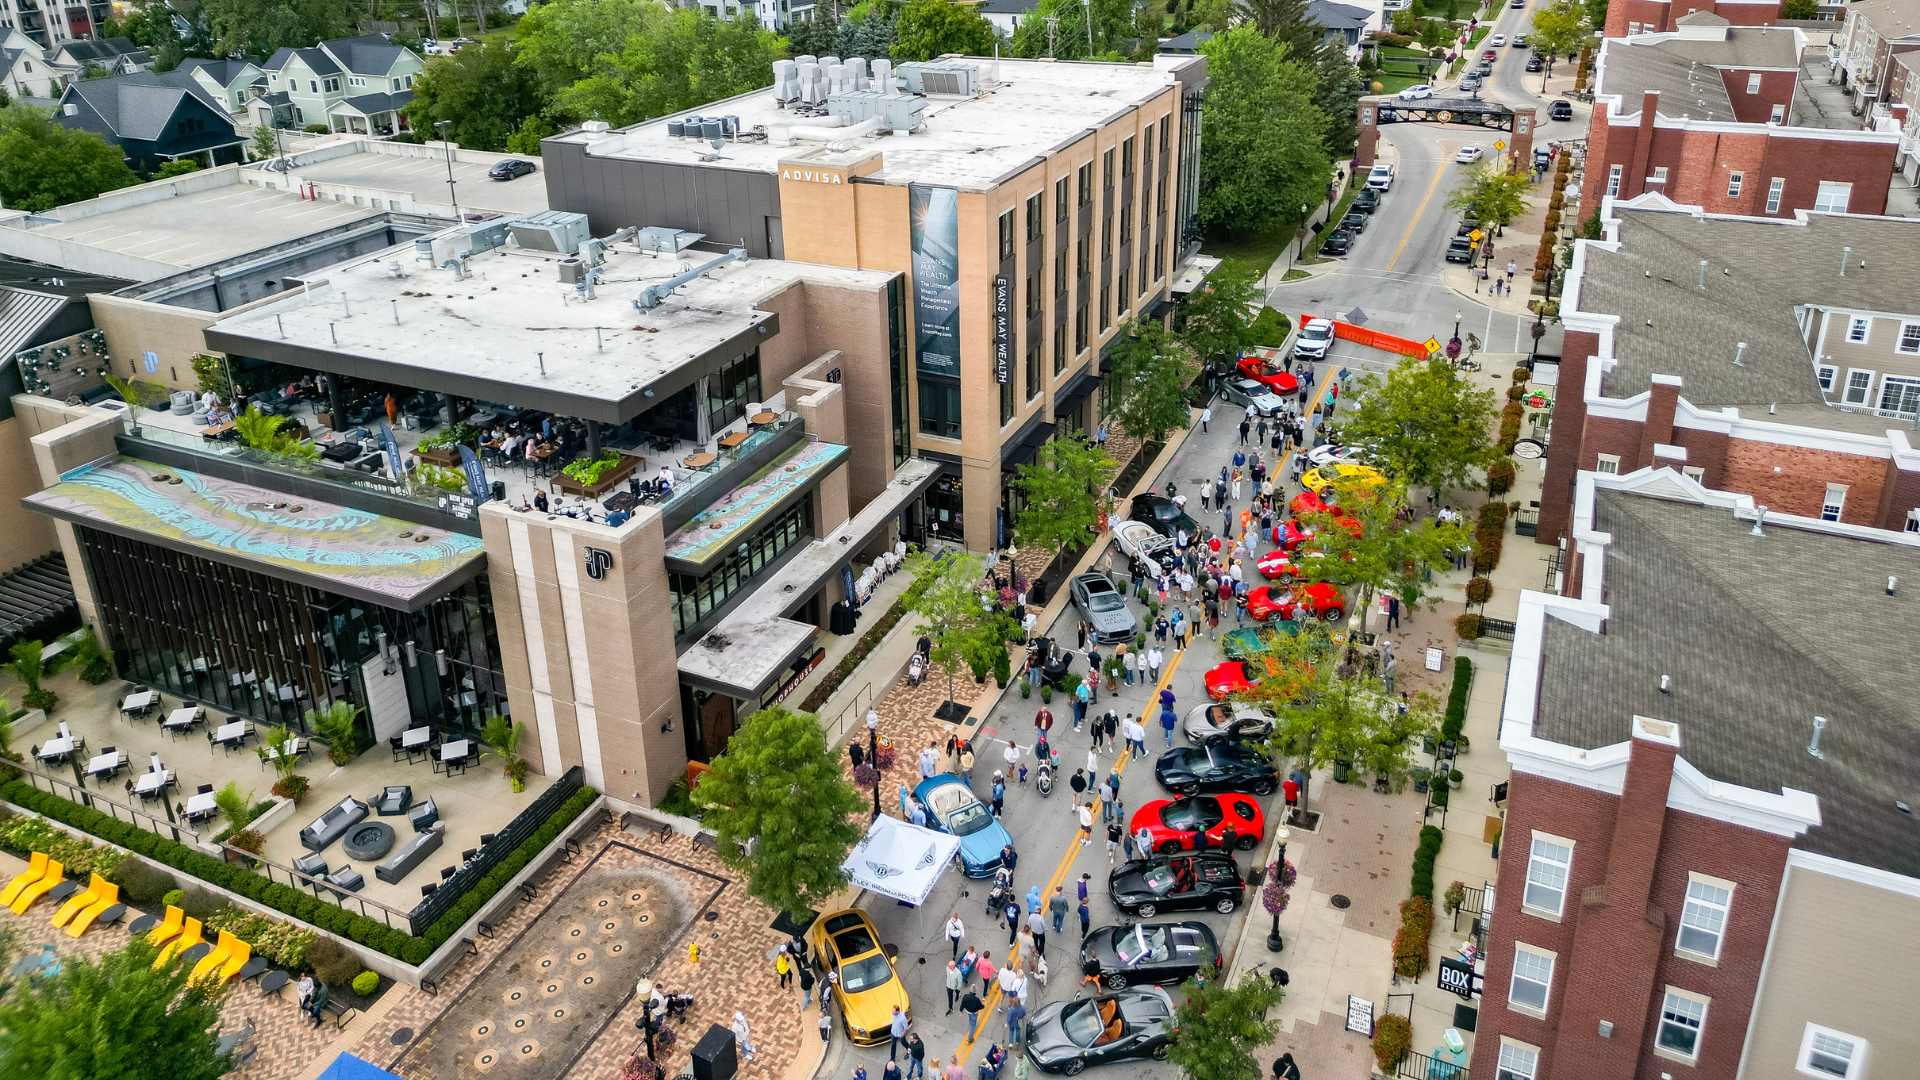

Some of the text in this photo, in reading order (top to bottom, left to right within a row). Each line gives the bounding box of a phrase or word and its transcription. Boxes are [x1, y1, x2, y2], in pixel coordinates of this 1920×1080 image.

[783, 169, 841, 184] ADVISA
[920, 264, 936, 272] MAY
[922, 256, 946, 265] EVANS
[920, 270, 949, 280] WEALTH
[998, 278, 1007, 383] EVANS MAY WEALTH
[774, 663, 814, 707] OPHOUSE
[871, 883, 917, 903] INDIANAPOLIS
[1441, 966, 1469, 988] BOX
[1440, 983, 1468, 995] MARKET
